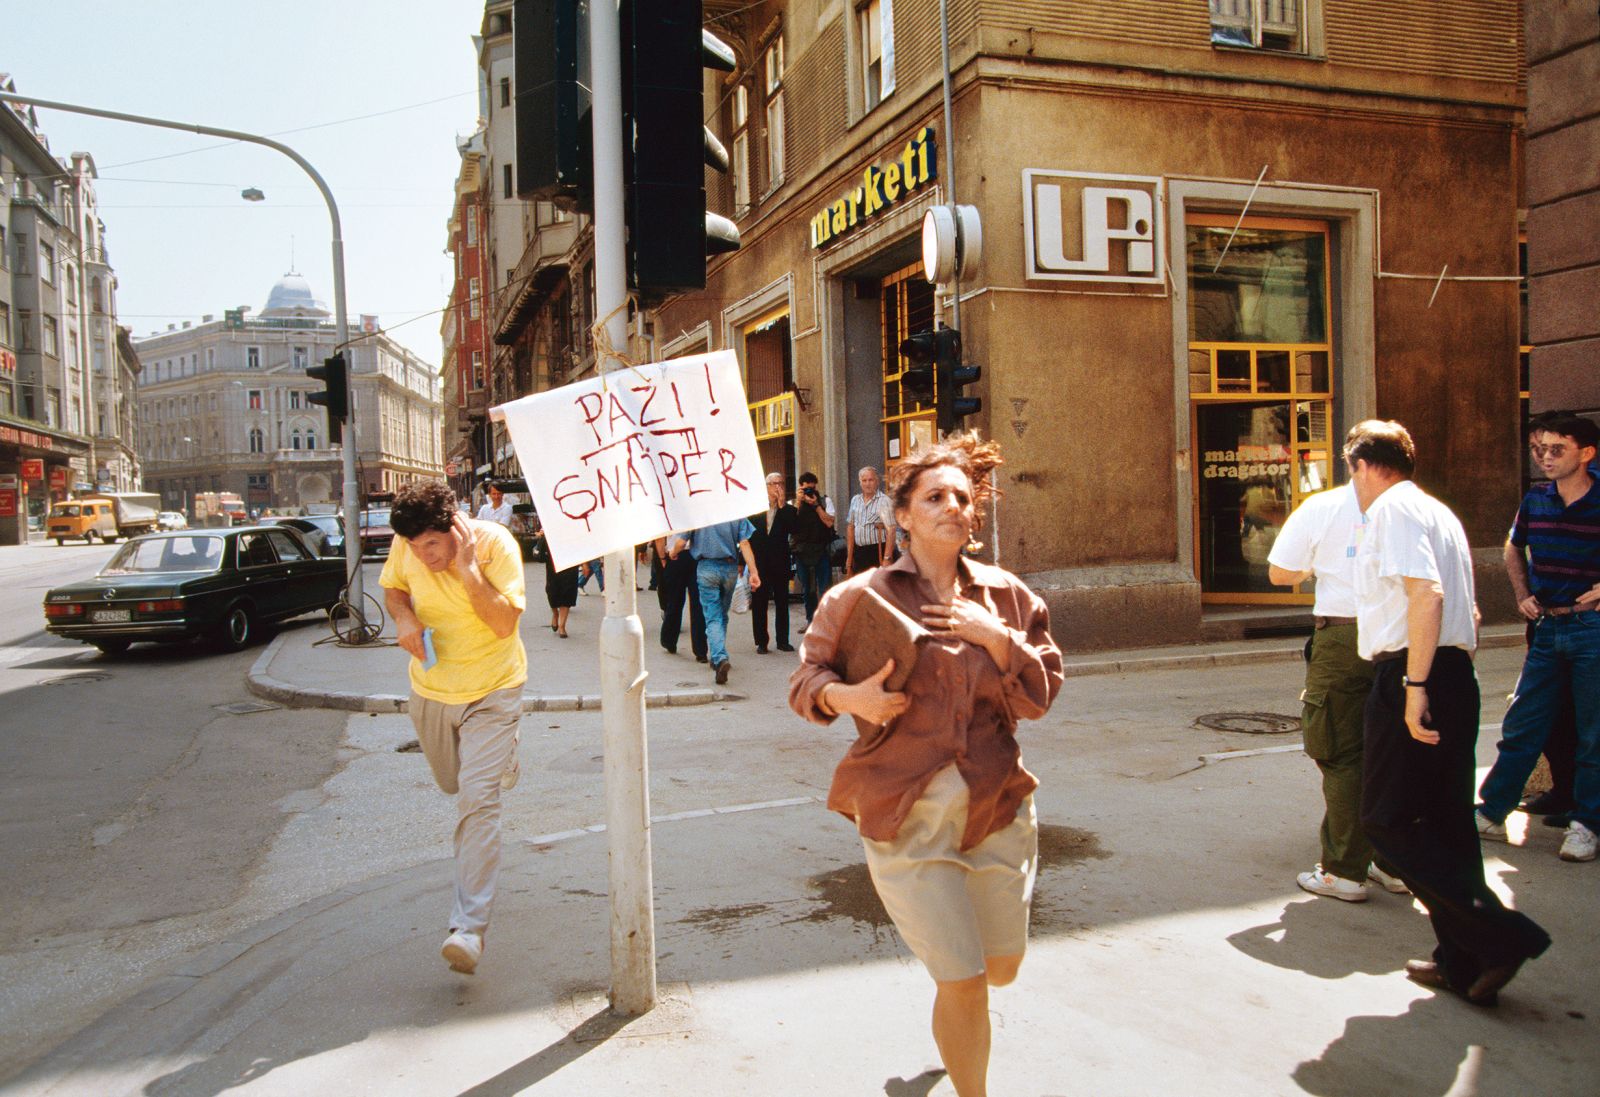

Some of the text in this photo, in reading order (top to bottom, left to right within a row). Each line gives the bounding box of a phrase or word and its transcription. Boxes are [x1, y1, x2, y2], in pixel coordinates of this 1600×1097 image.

[809, 127, 933, 249] marketi
[553, 447, 748, 532] SNAJPER
[1203, 463, 1290, 480] dragstor
